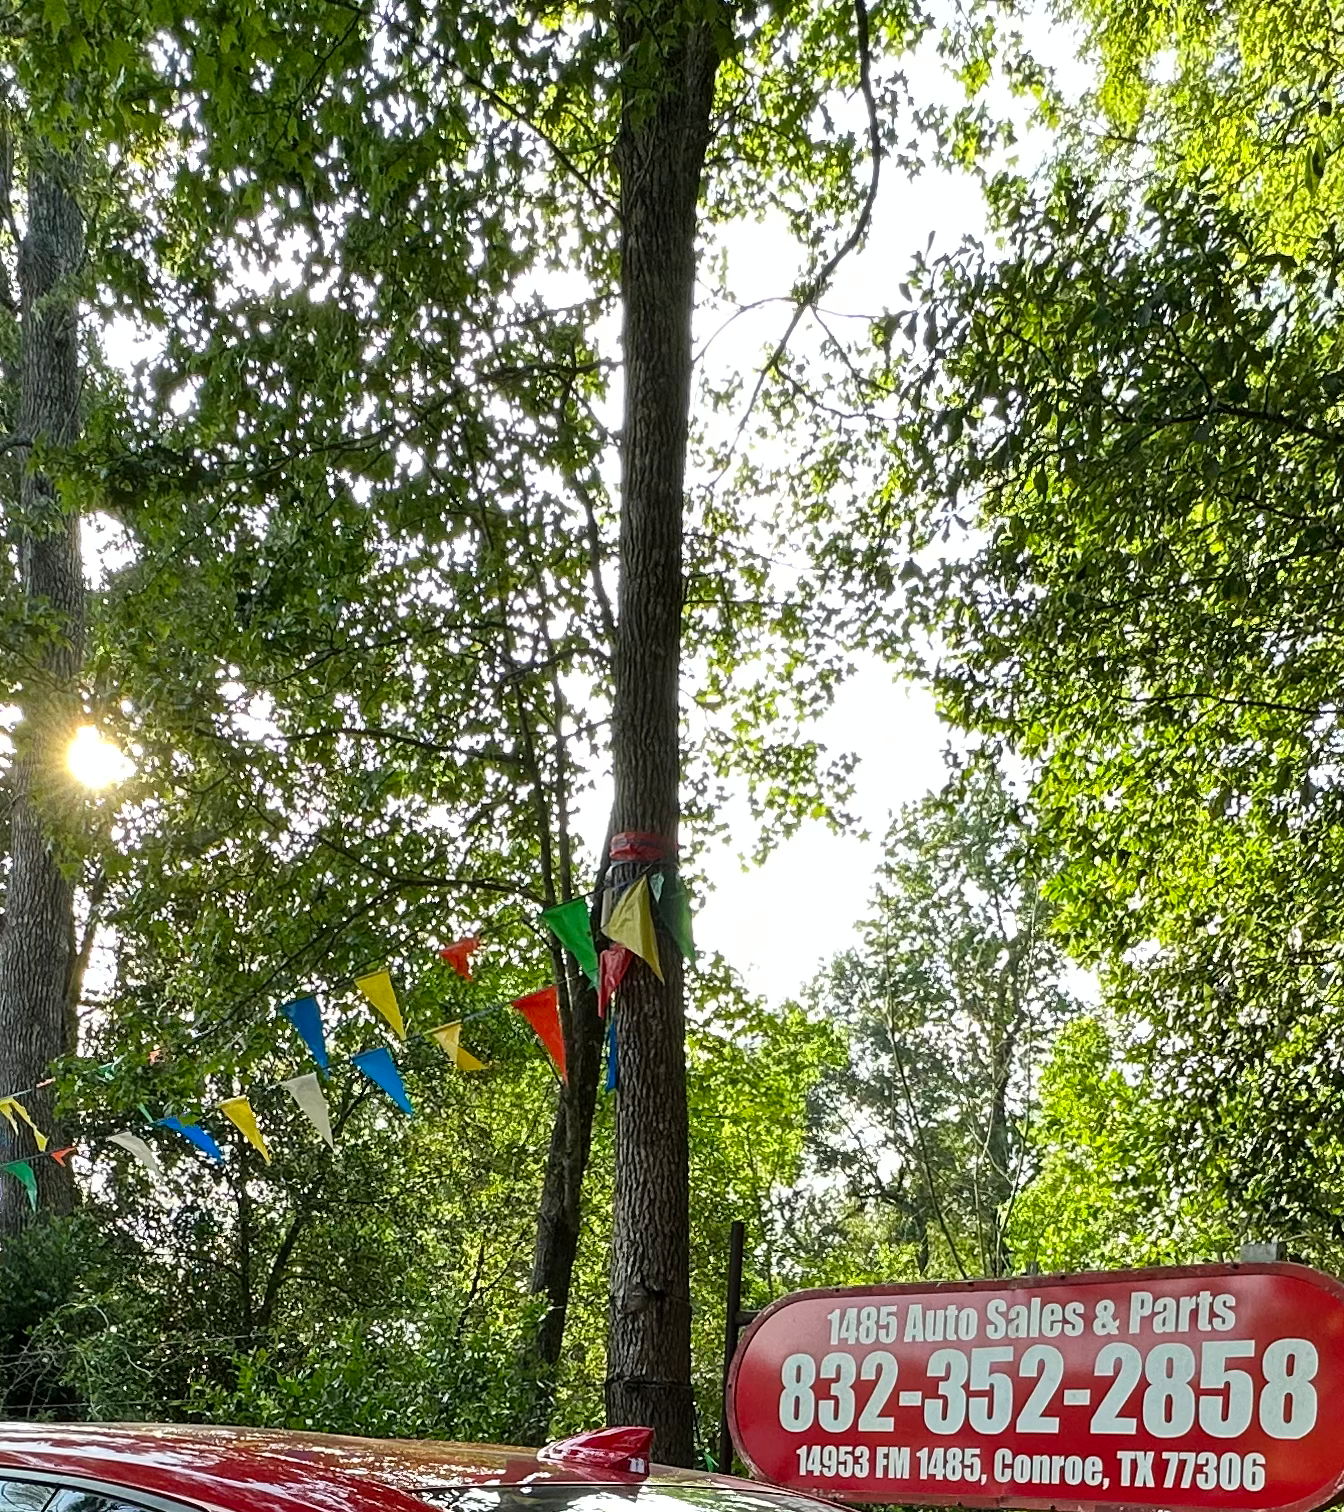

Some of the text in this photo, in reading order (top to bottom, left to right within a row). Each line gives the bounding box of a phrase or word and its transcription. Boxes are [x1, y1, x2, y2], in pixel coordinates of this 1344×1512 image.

[827, 1290, 1237, 1345] 1485 Auto Sales & Parts
[778, 1337, 1319, 1440] 832-352-2858
[796, 1445, 1267, 1492] 14953 FM 1485, Conroe, TX 77306
